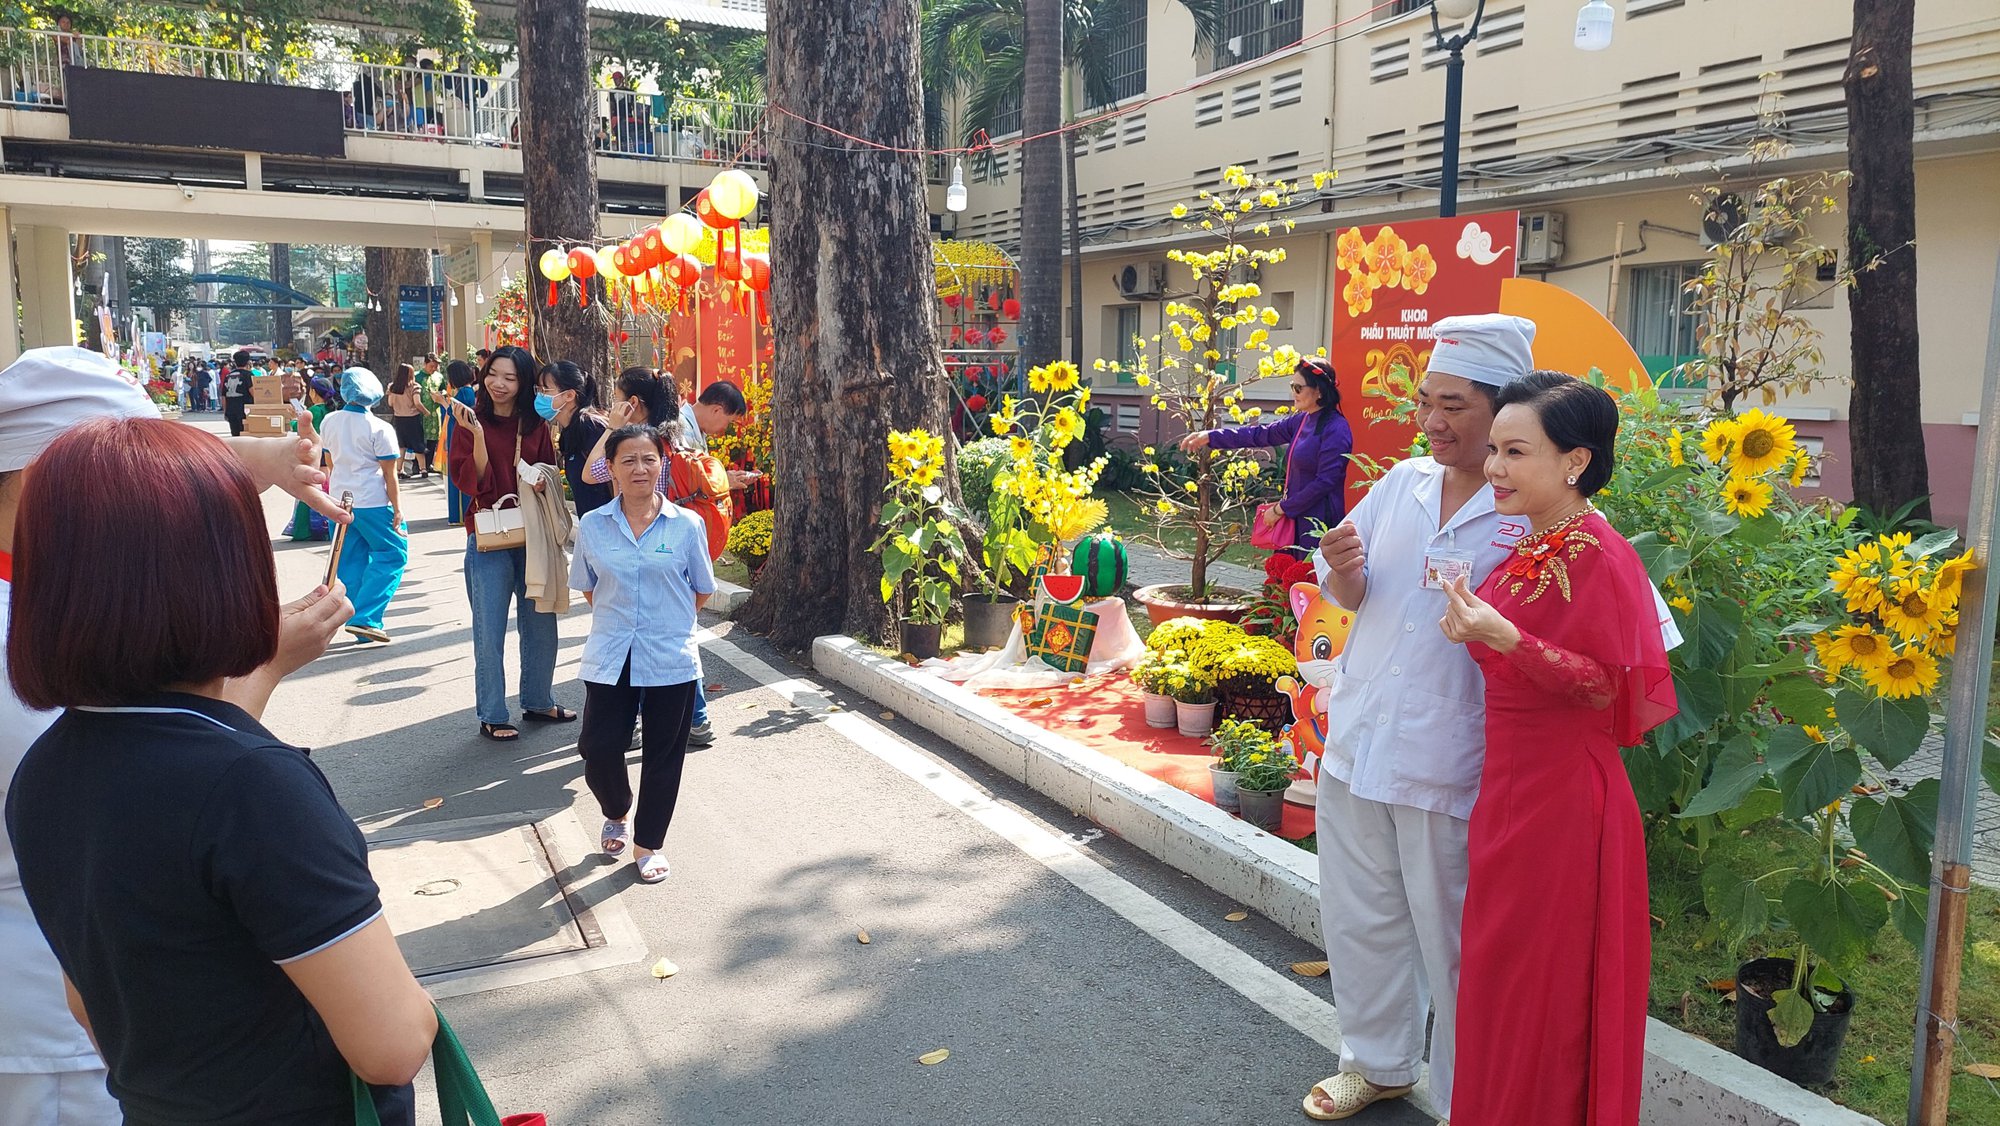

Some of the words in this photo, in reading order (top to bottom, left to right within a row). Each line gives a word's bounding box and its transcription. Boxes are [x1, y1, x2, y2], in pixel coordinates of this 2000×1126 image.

[1401, 309, 1428, 322] KHOA
[1361, 323, 1384, 340] PHẪU
[1386, 325, 1415, 342] THUẬT
